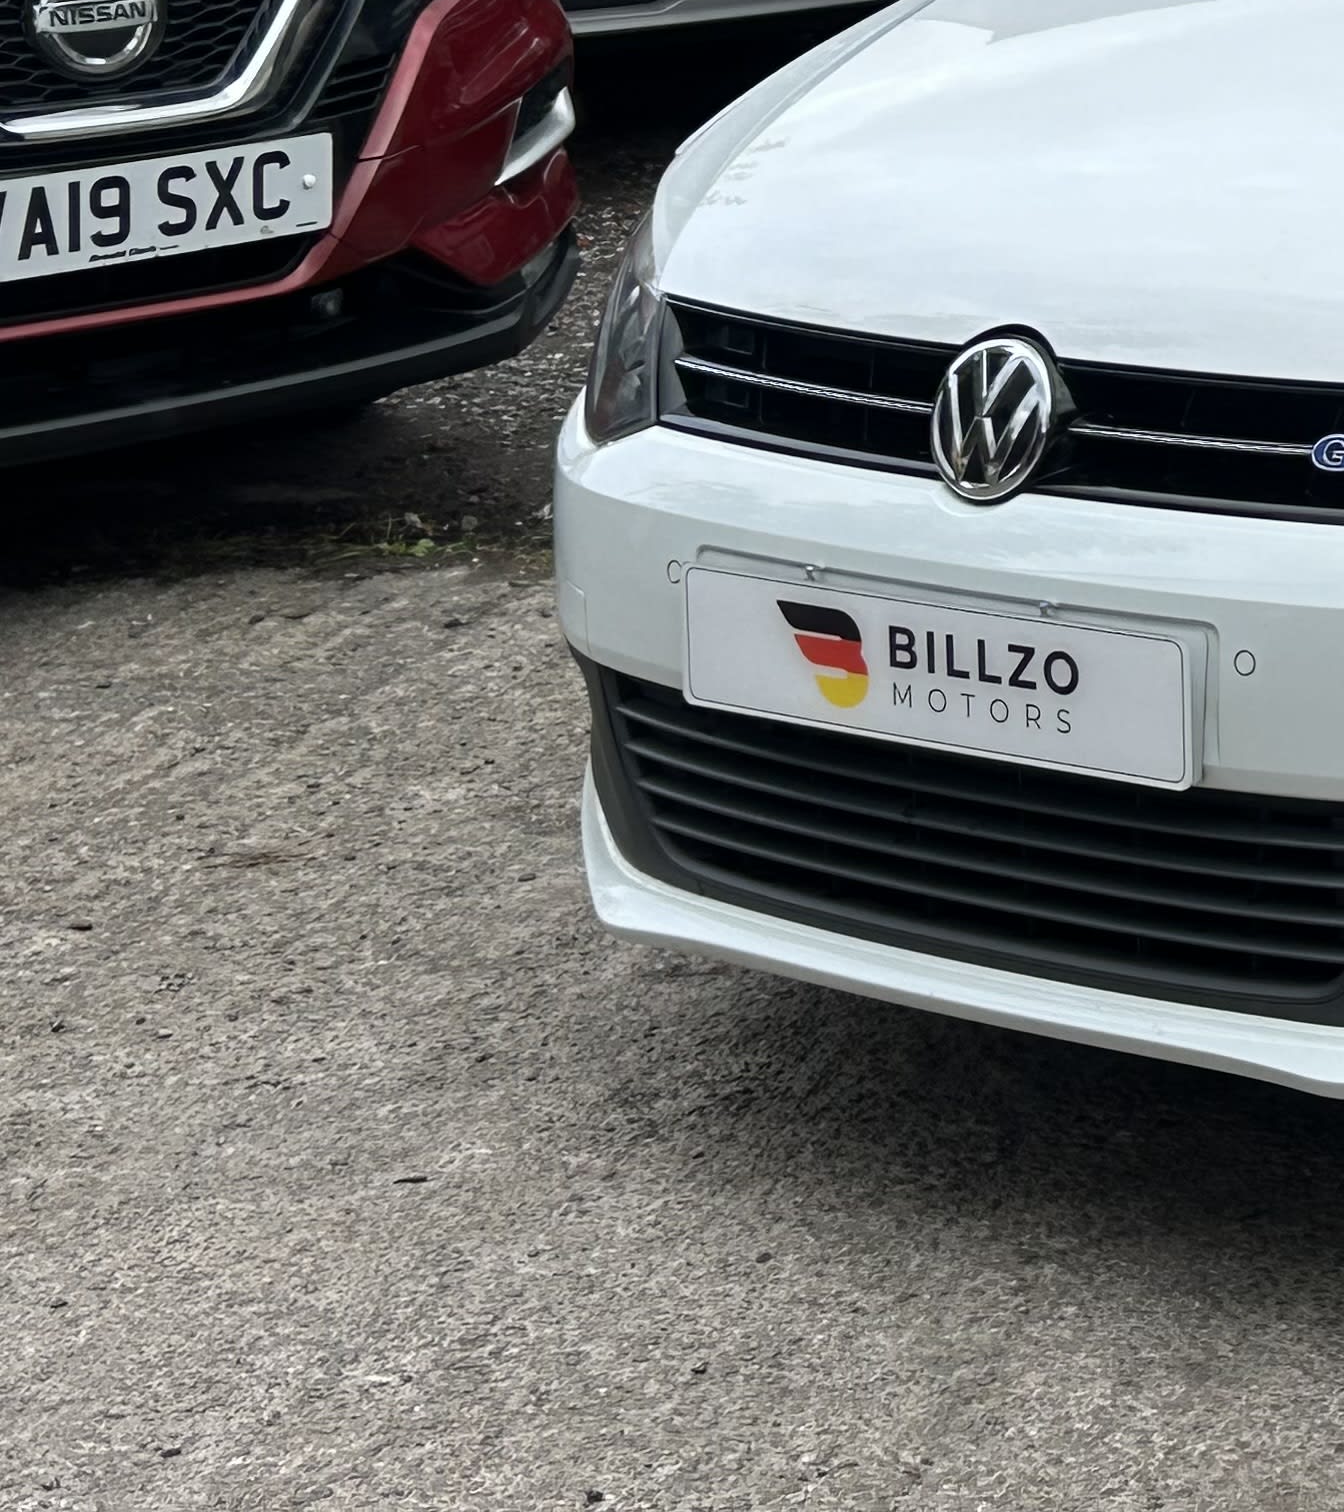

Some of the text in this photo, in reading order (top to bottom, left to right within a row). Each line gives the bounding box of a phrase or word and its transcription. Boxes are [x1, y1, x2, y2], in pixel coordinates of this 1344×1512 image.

[48, 0, 147, 28] NISSAN
[0, 150, 291, 261] A19 SXC
[888, 624, 1080, 696] BILLZO
[892, 681, 1073, 734] MOTORS
